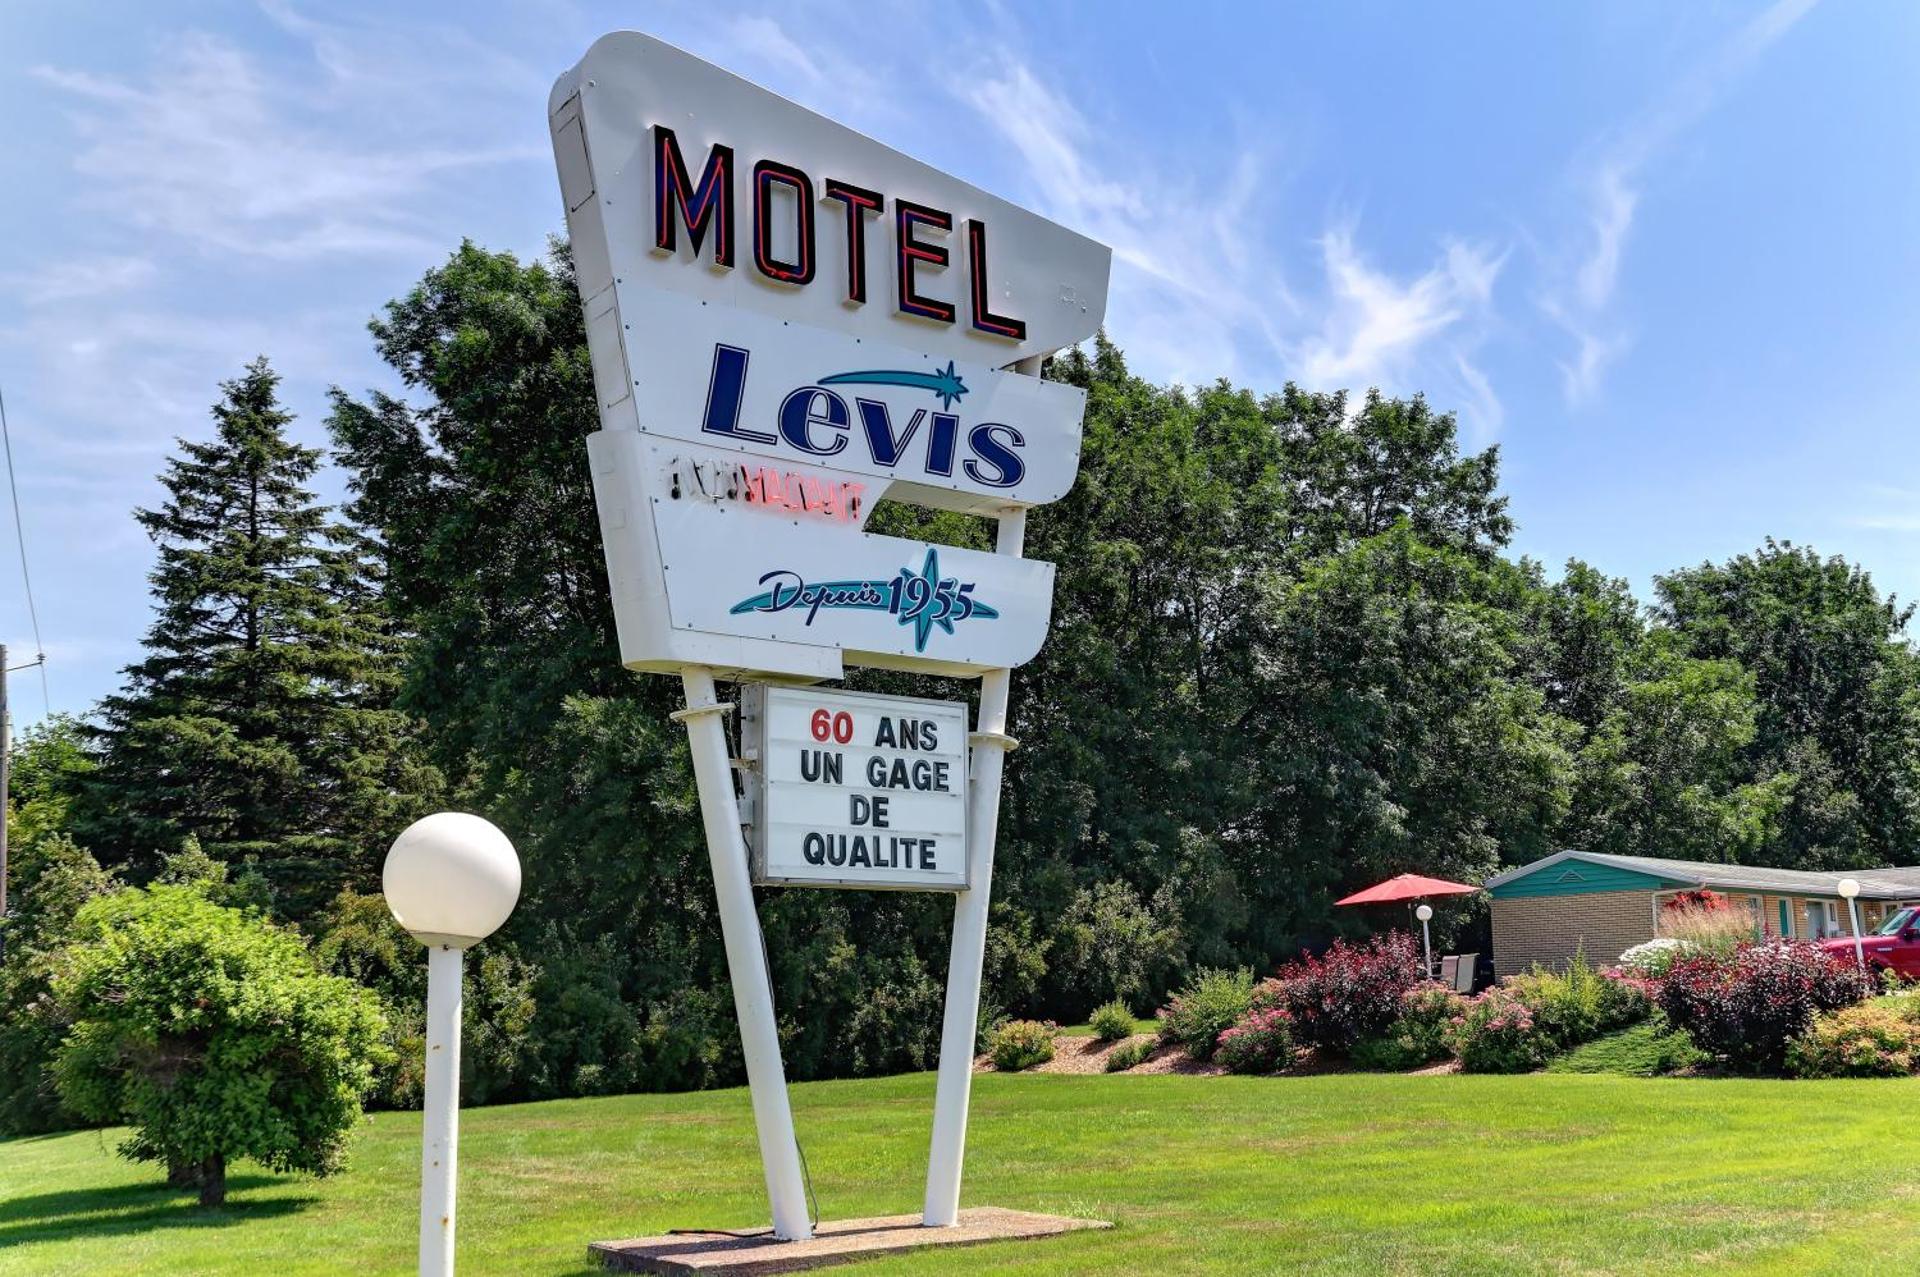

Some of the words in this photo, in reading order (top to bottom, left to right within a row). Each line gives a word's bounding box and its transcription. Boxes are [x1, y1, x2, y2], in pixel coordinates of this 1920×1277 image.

[650, 124, 1026, 342] MOTEL
[702, 343, 1025, 487] Levis
[757, 571, 882, 626] Depuis
[888, 577, 976, 621] 1955
[811, 709, 853, 744] 60
[875, 717, 938, 751] ANS
[801, 750, 843, 784] UN
[867, 756, 949, 792] GAGE
[850, 795, 889, 828] DE
[803, 832, 937, 870] QUALITE
